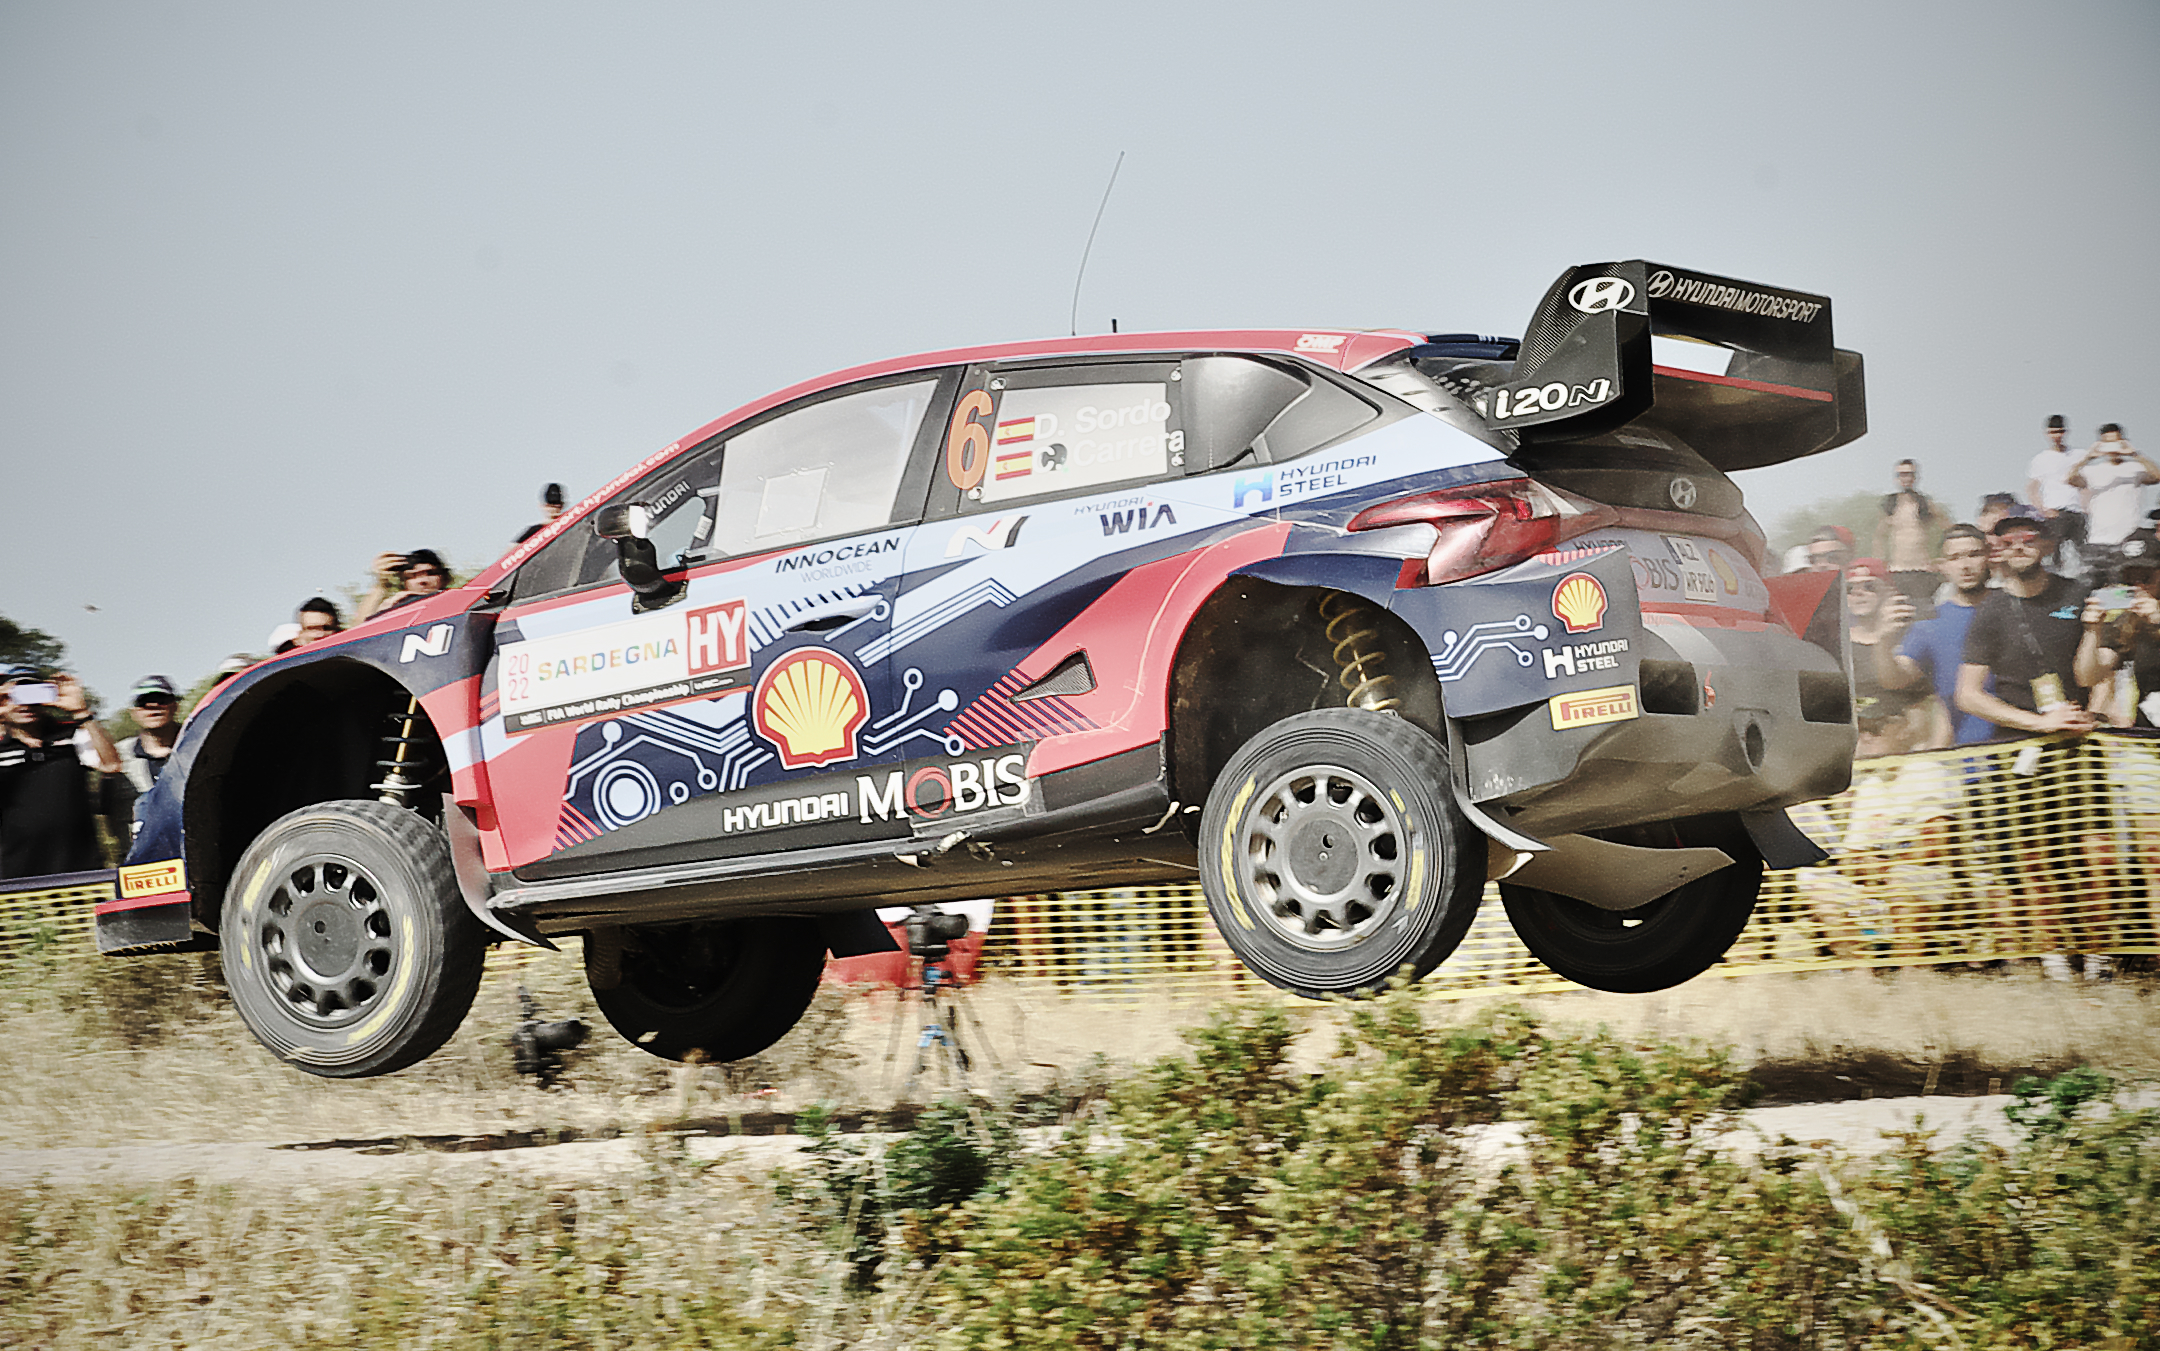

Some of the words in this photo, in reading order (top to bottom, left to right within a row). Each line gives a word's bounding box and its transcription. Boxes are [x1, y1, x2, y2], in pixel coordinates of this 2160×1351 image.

[1034, 412, 1064, 441] D.
[1074, 398, 1172, 434] Sordo
[946, 389, 994, 491] 6
[1072, 429, 1185, 467] Carrera
[1280, 455, 1378, 481] HYUNDAI
[1279, 474, 1348, 498] STEEL
[1073, 495, 1145, 516] HYUNDAI
[1099, 501, 1178, 537] WIA
[775, 536, 901, 574] INNOCEAN
[799, 559, 873, 584] WORLDWIDE
[687, 605, 745, 670] HY
[1574, 637, 1630, 659] HYUNDAI
[508, 652, 530, 677] 20
[536, 638, 679, 682] SARDEGNA
[1577, 655, 1620, 674] STEEL
[508, 676, 530, 702] 22
[1559, 691, 1633, 722] PIRELLI
[722, 791, 850, 834] HYUNDAI
[854, 753, 1032, 825] MOBIS
[123, 866, 178, 892] PIRELLI
